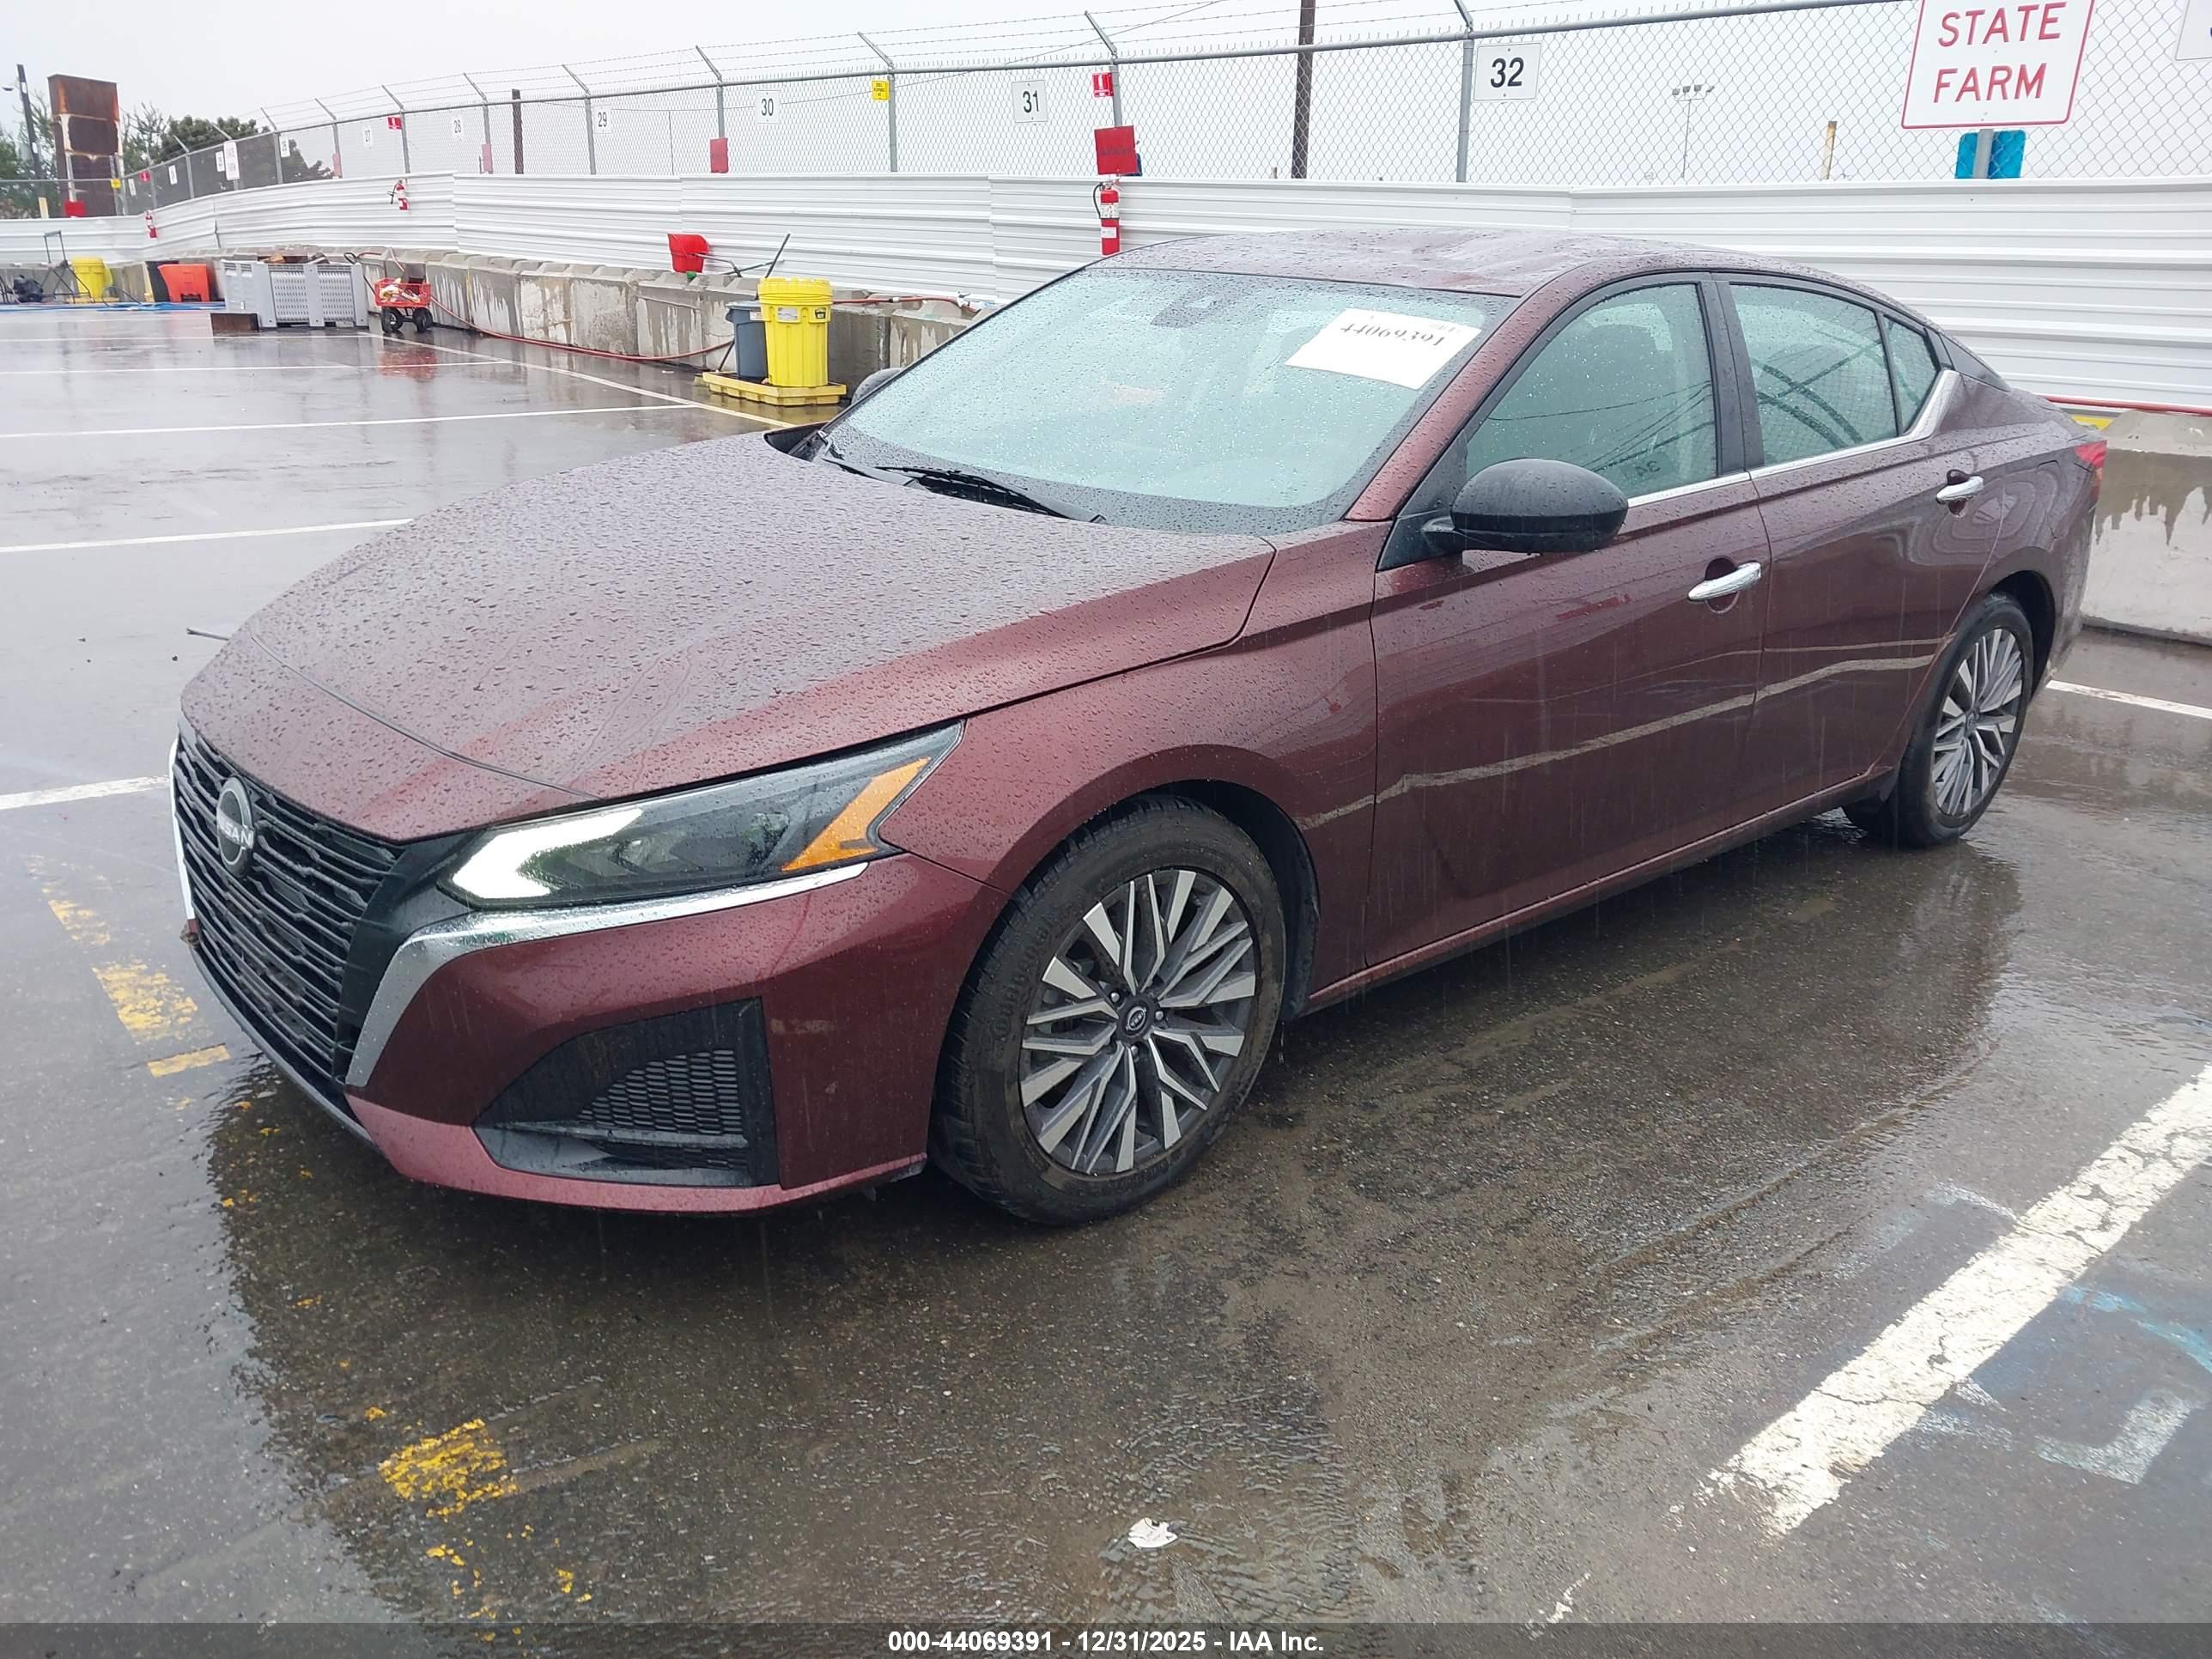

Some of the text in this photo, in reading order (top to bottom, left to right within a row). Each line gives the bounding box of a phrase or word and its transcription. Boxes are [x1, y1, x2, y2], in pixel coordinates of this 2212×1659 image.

[1937, 2, 2067, 46] STATE
[1490, 57, 1524, 88] 32
[1933, 63, 2047, 103] FARM
[761, 98, 774, 116] 30
[1023, 89, 1039, 112] 31
[454, 119, 462, 133] 28
[598, 112, 607, 127] 29
